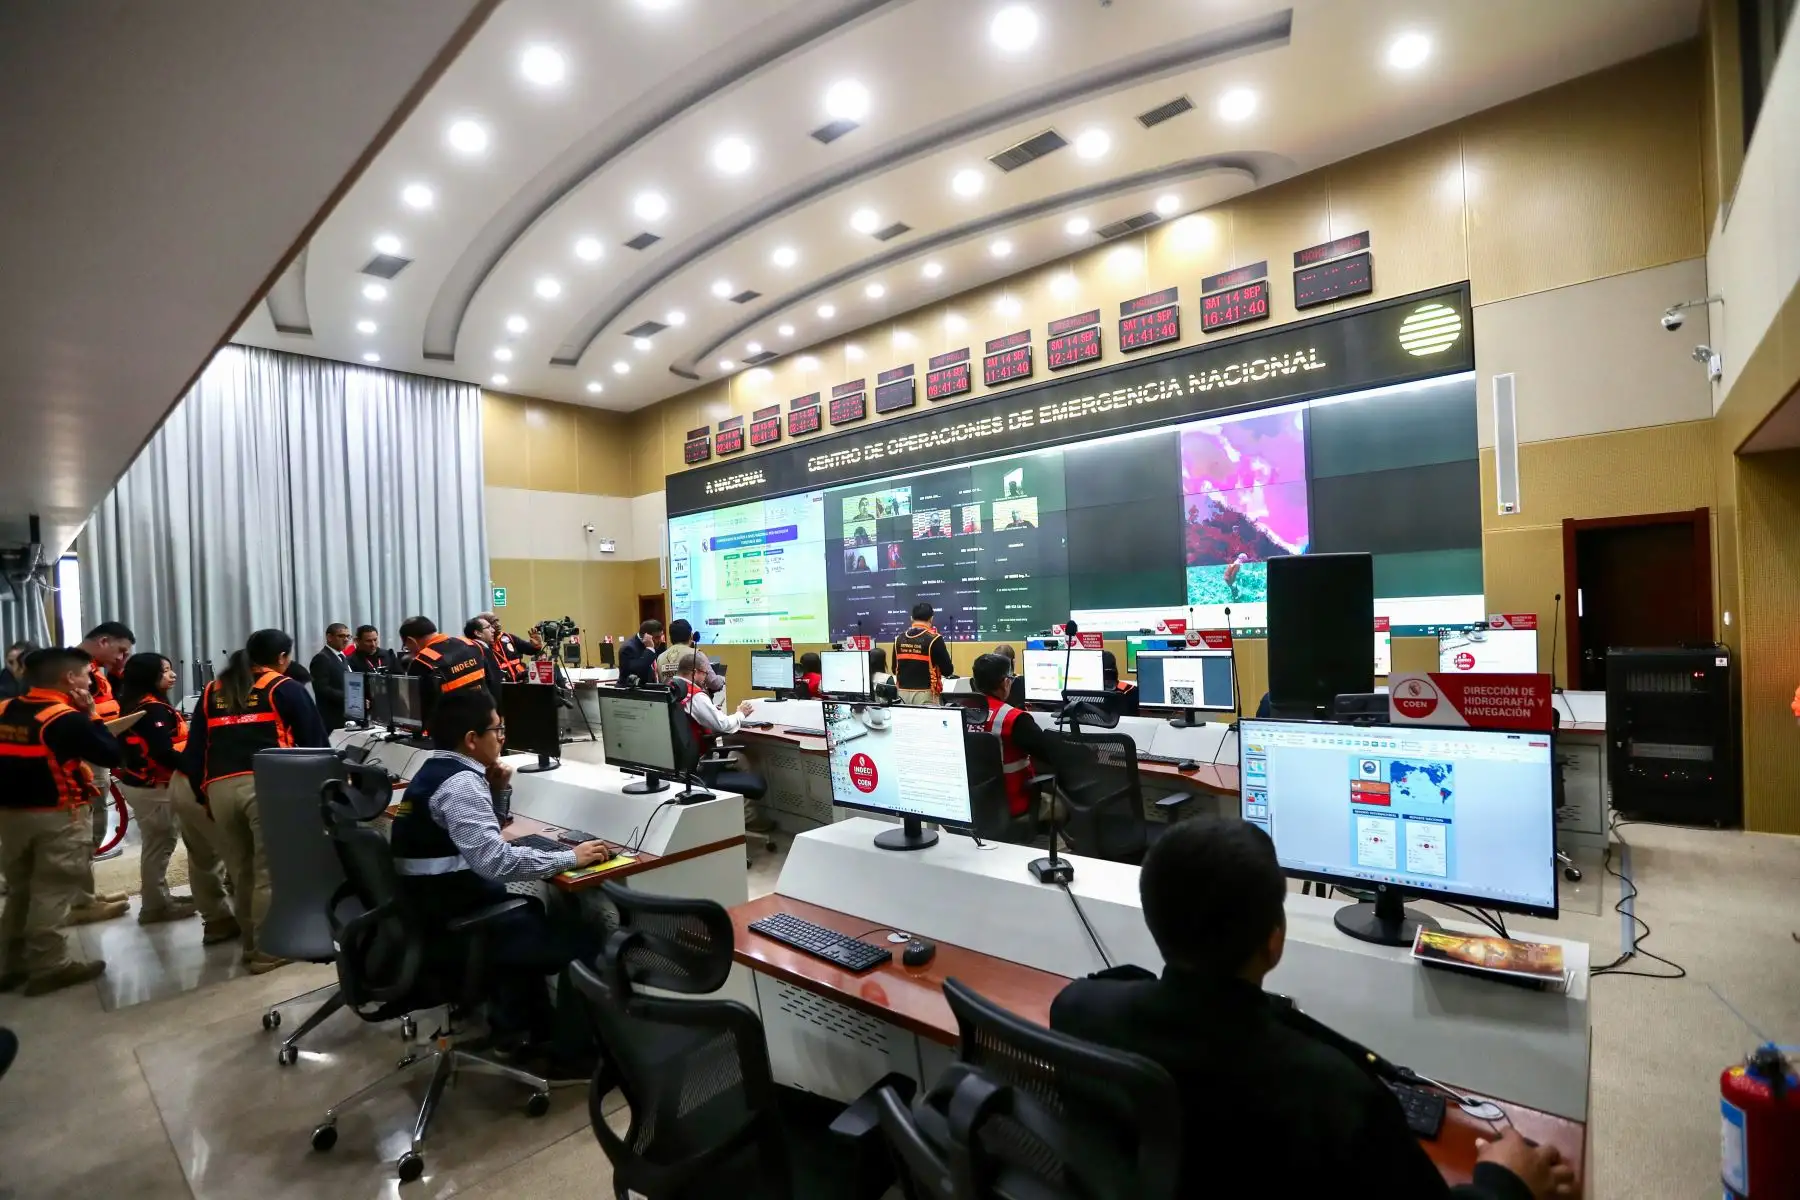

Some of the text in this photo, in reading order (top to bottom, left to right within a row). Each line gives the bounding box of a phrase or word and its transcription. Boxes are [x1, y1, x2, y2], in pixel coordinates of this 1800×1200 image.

[1205, 285, 1261, 310] SAT 14 SEP
[1123, 309, 1172, 332] SAT 14 SEP
[1203, 300, 1266, 327] 16:41:40
[1051, 330, 1094, 351] SAT 14 SEP
[1121, 323, 1176, 347] 14:41:40
[987, 350, 1026, 368] SAT 14 SEP
[1048, 343, 1098, 366] 12:41:40
[942, 370, 952, 381] 14
[952, 367, 965, 378] SEP
[985, 361, 1029, 381] 11:41:40
[928, 378, 967, 396] 09:41:40
[807, 348, 1327, 473] CENTRO DE OPERACIONES DE EMERGENCIA NACIONAL
[451, 658, 477, 674] INDECI
[1463, 685, 1536, 696] DIRECCIÓN DE
[1403, 699, 1428, 708] COEN
[1463, 695, 1545, 707] HIDROGRAFÍA Y
[1464, 706, 1531, 718] NAVEGACIÓN
[853, 766, 873, 774] INDECI
[857, 779, 872, 787] COEN
